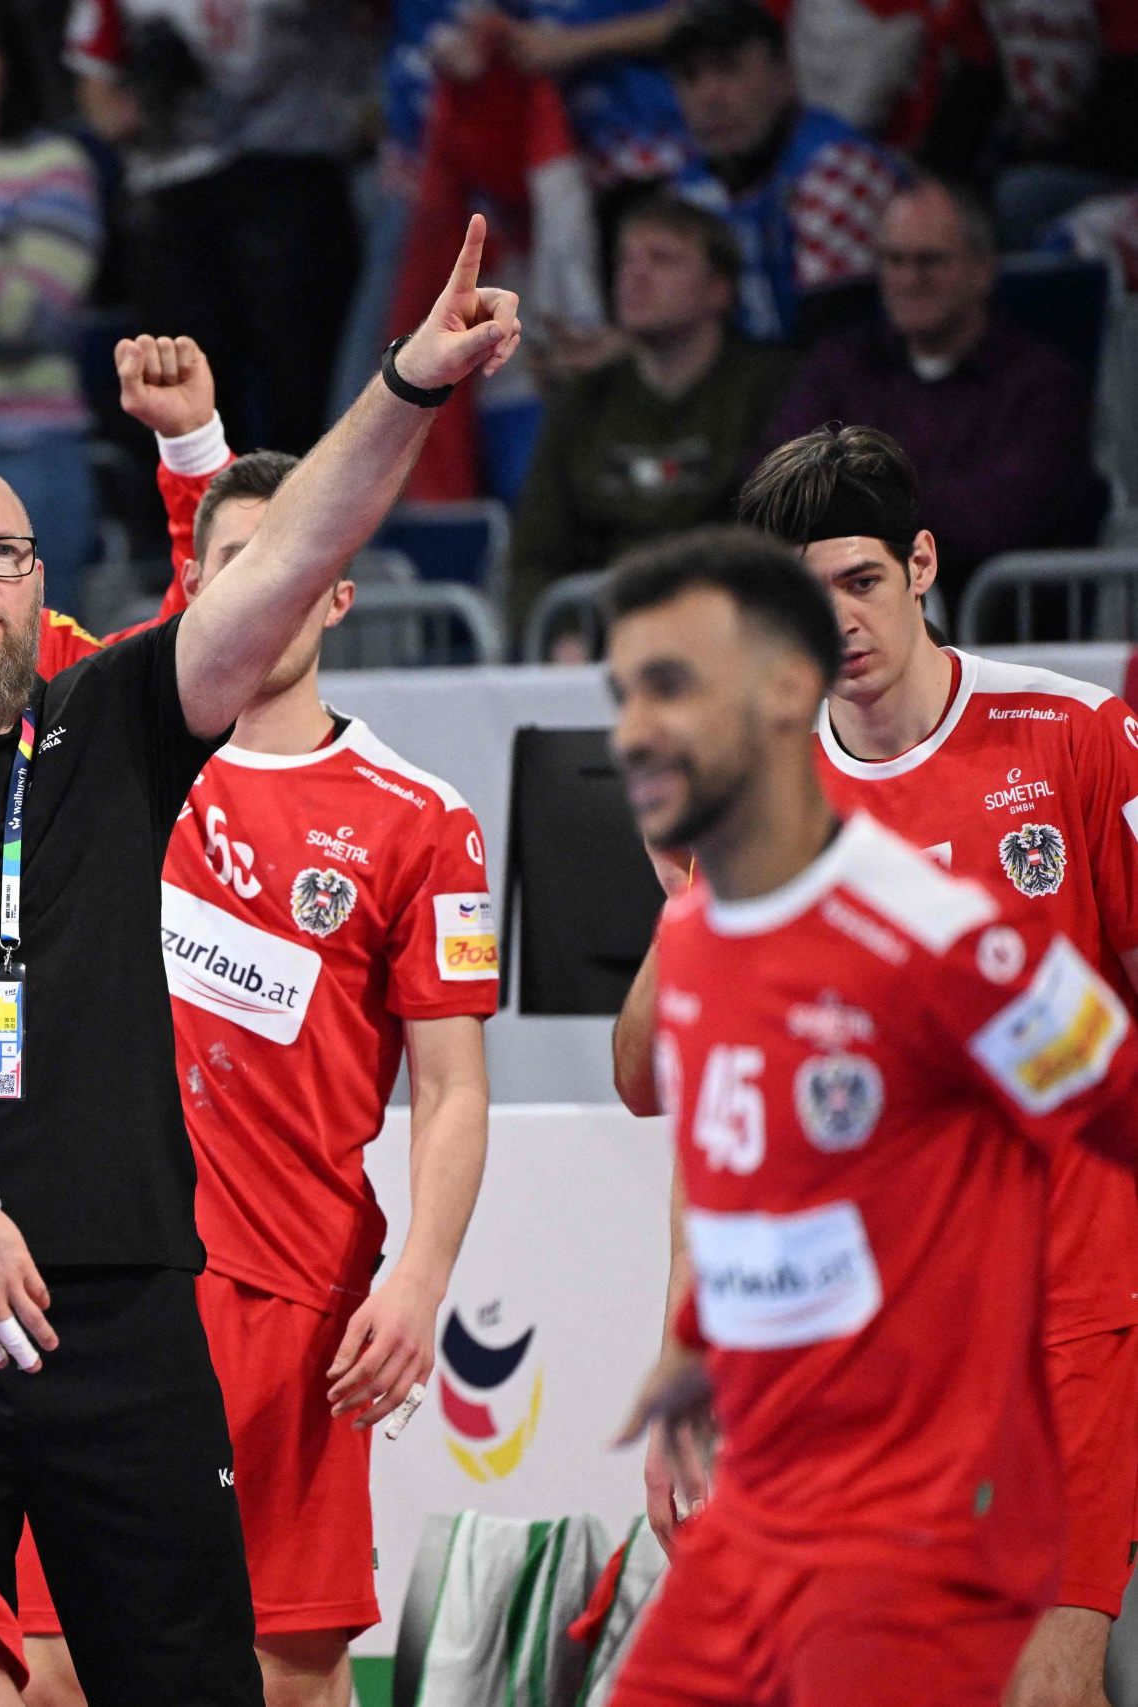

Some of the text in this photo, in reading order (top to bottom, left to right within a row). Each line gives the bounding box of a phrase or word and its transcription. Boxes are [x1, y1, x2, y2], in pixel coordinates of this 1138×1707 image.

[13, 767, 28, 815] walbusch
[984, 780, 1055, 811] SOMETAL
[1009, 801, 1035, 815] GMBH
[306, 829, 369, 865] SOMETAL
[692, 1044, 767, 1176] 45
